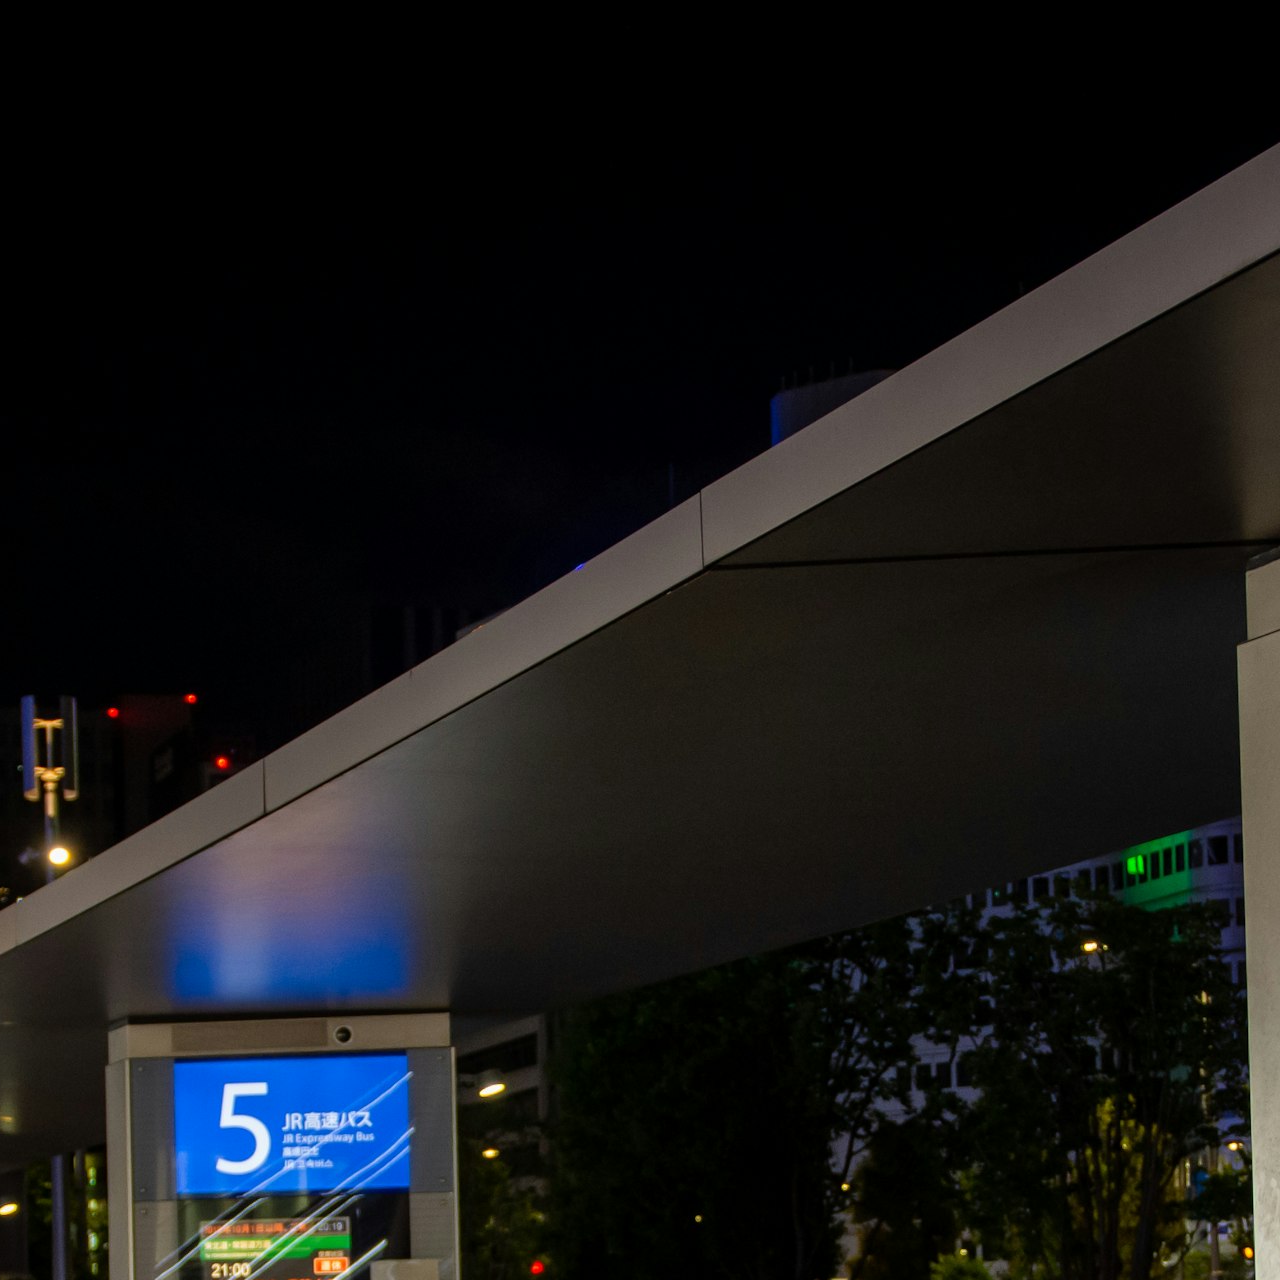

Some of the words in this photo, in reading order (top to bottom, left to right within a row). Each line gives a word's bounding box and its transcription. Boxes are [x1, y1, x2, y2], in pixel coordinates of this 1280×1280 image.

[216, 1082, 271, 1175] 5
[281, 1110, 373, 1131] JR高速バス
[282, 1133, 294, 1144] JR
[356, 1131, 375, 1142] Bus
[211, 1262, 251, 1278] 21:00
